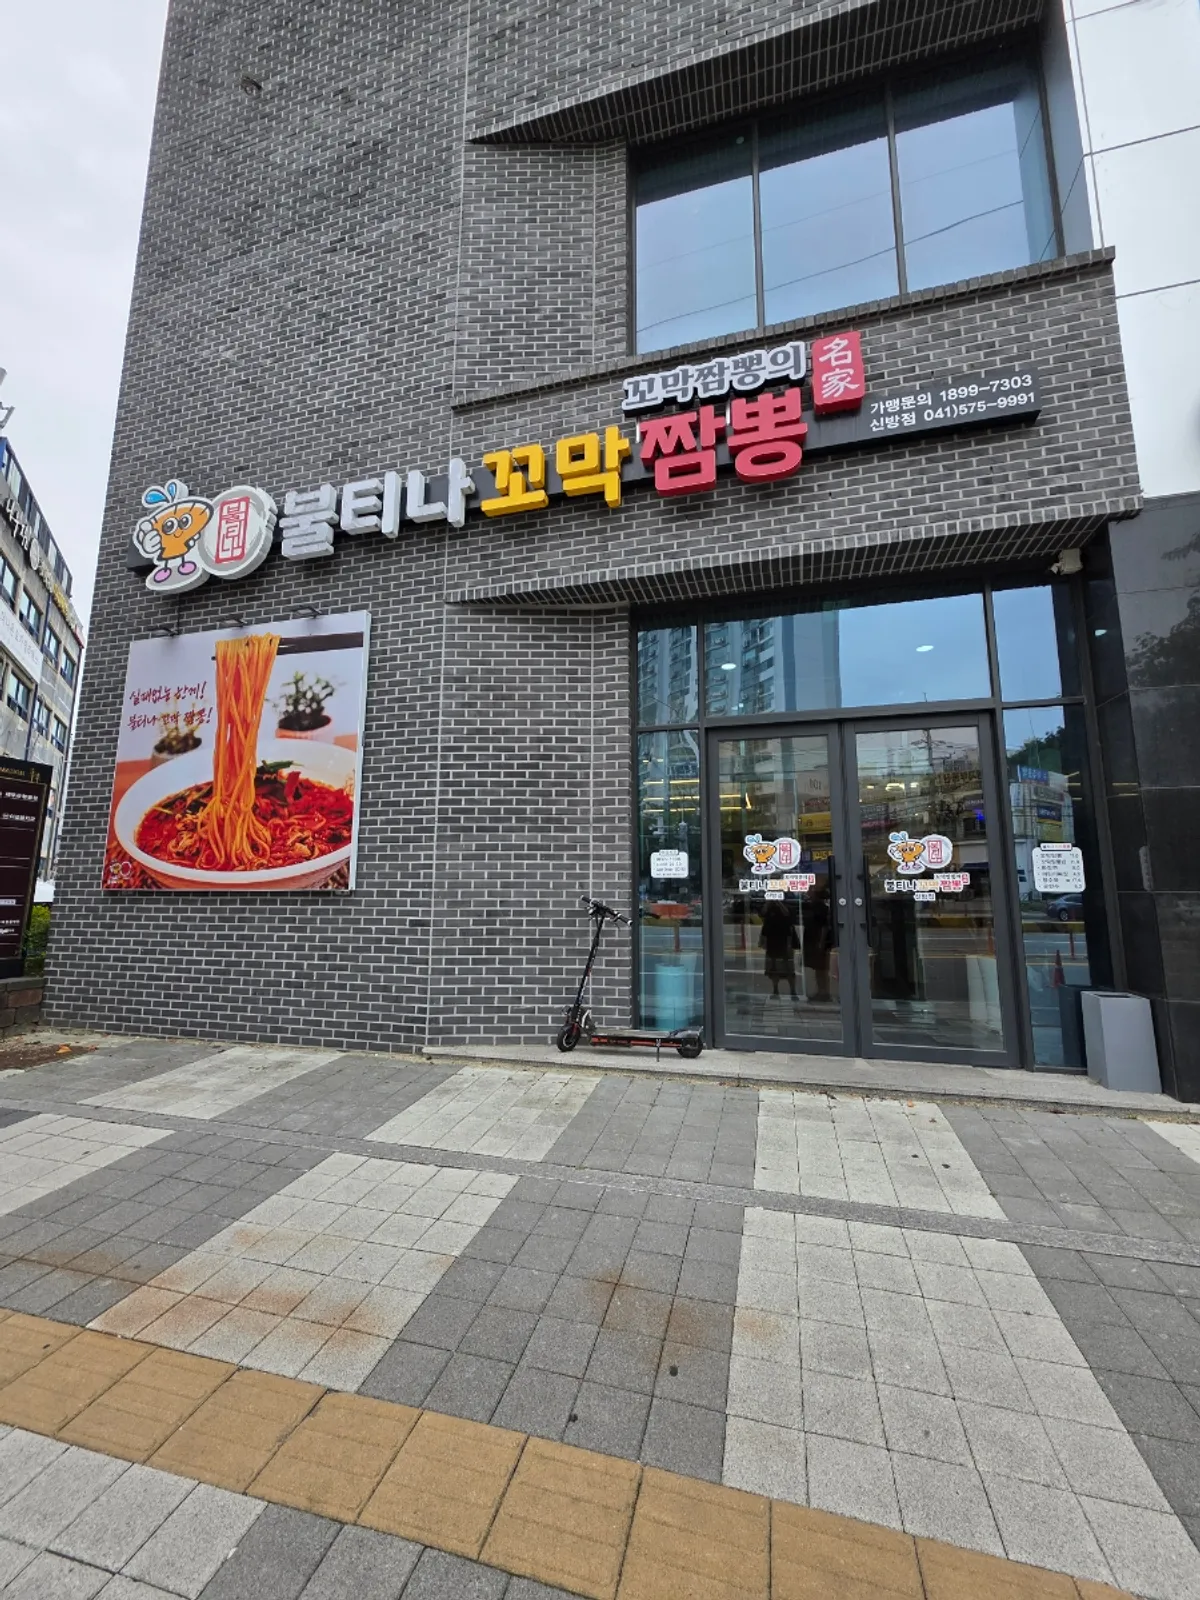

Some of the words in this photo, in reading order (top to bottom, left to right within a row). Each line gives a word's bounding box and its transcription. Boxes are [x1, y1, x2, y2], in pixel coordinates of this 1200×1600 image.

[622, 342, 805, 408] 꼬막짬뽕의
[818, 337, 860, 399] 名家
[869, 392, 932, 416] 가맹문의
[938, 373, 1033, 402] 1899-7303
[869, 411, 917, 433] 신방점
[923, 391, 1036, 422] 041)575-9991
[480, 424, 631, 517] 꼬막
[637, 386, 809, 498] 짬뽕
